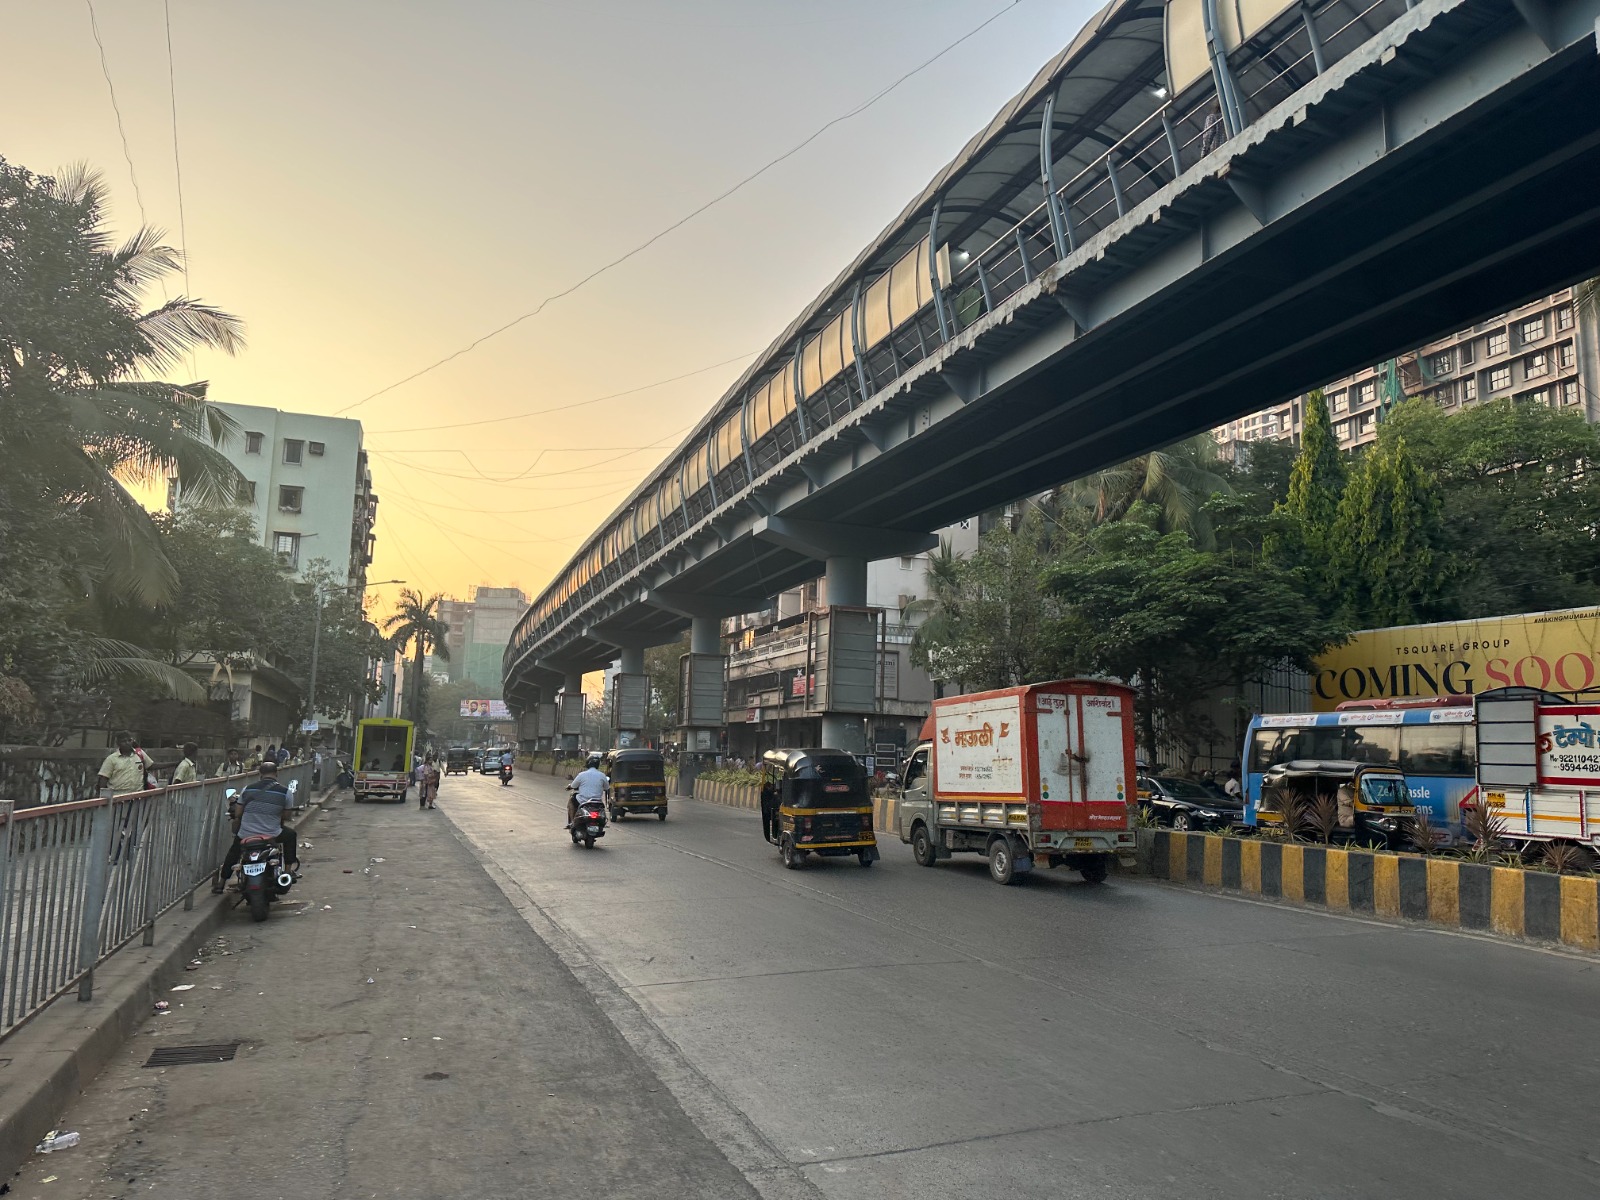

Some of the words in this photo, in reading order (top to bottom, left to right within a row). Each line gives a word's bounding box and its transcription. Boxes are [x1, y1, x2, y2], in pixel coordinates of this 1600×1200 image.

[1396, 643, 1455, 656] TSQUARE
[1462, 638, 1510, 651] GROUP
[1315, 660, 1475, 699] COMING
[1486, 650, 1600, 692] SOO
[1559, 754, 1600, 763] 92211042
[1560, 763, 1600, 772] 9594482
